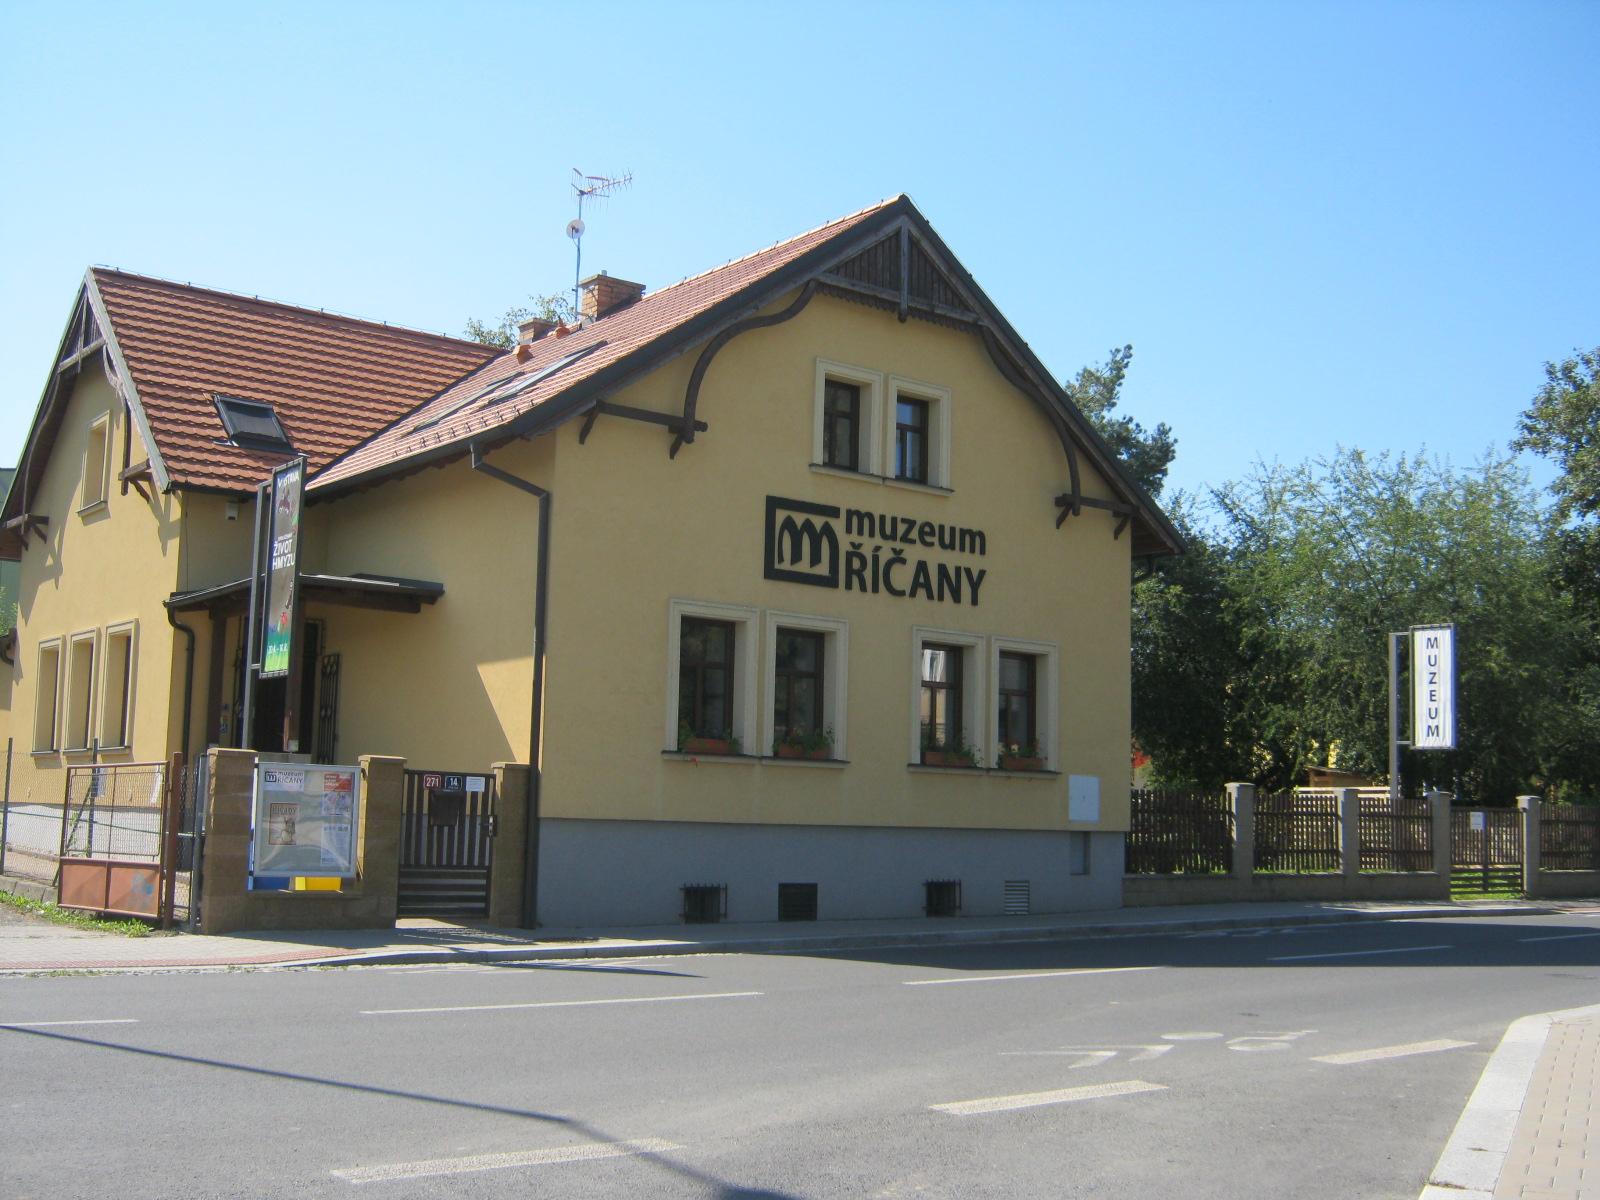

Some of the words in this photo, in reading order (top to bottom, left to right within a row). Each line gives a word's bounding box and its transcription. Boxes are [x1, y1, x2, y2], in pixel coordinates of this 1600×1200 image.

[845, 508, 986, 556] muzeum
[273, 540, 293, 557] ŽIVOT
[272, 552, 296, 571] HMYZU
[845, 541, 987, 607] ŘÍČANY
[1426, 637, 1439, 737] MUZEUM
[426, 777, 439, 787] 271
[450, 777, 458, 786] 14
